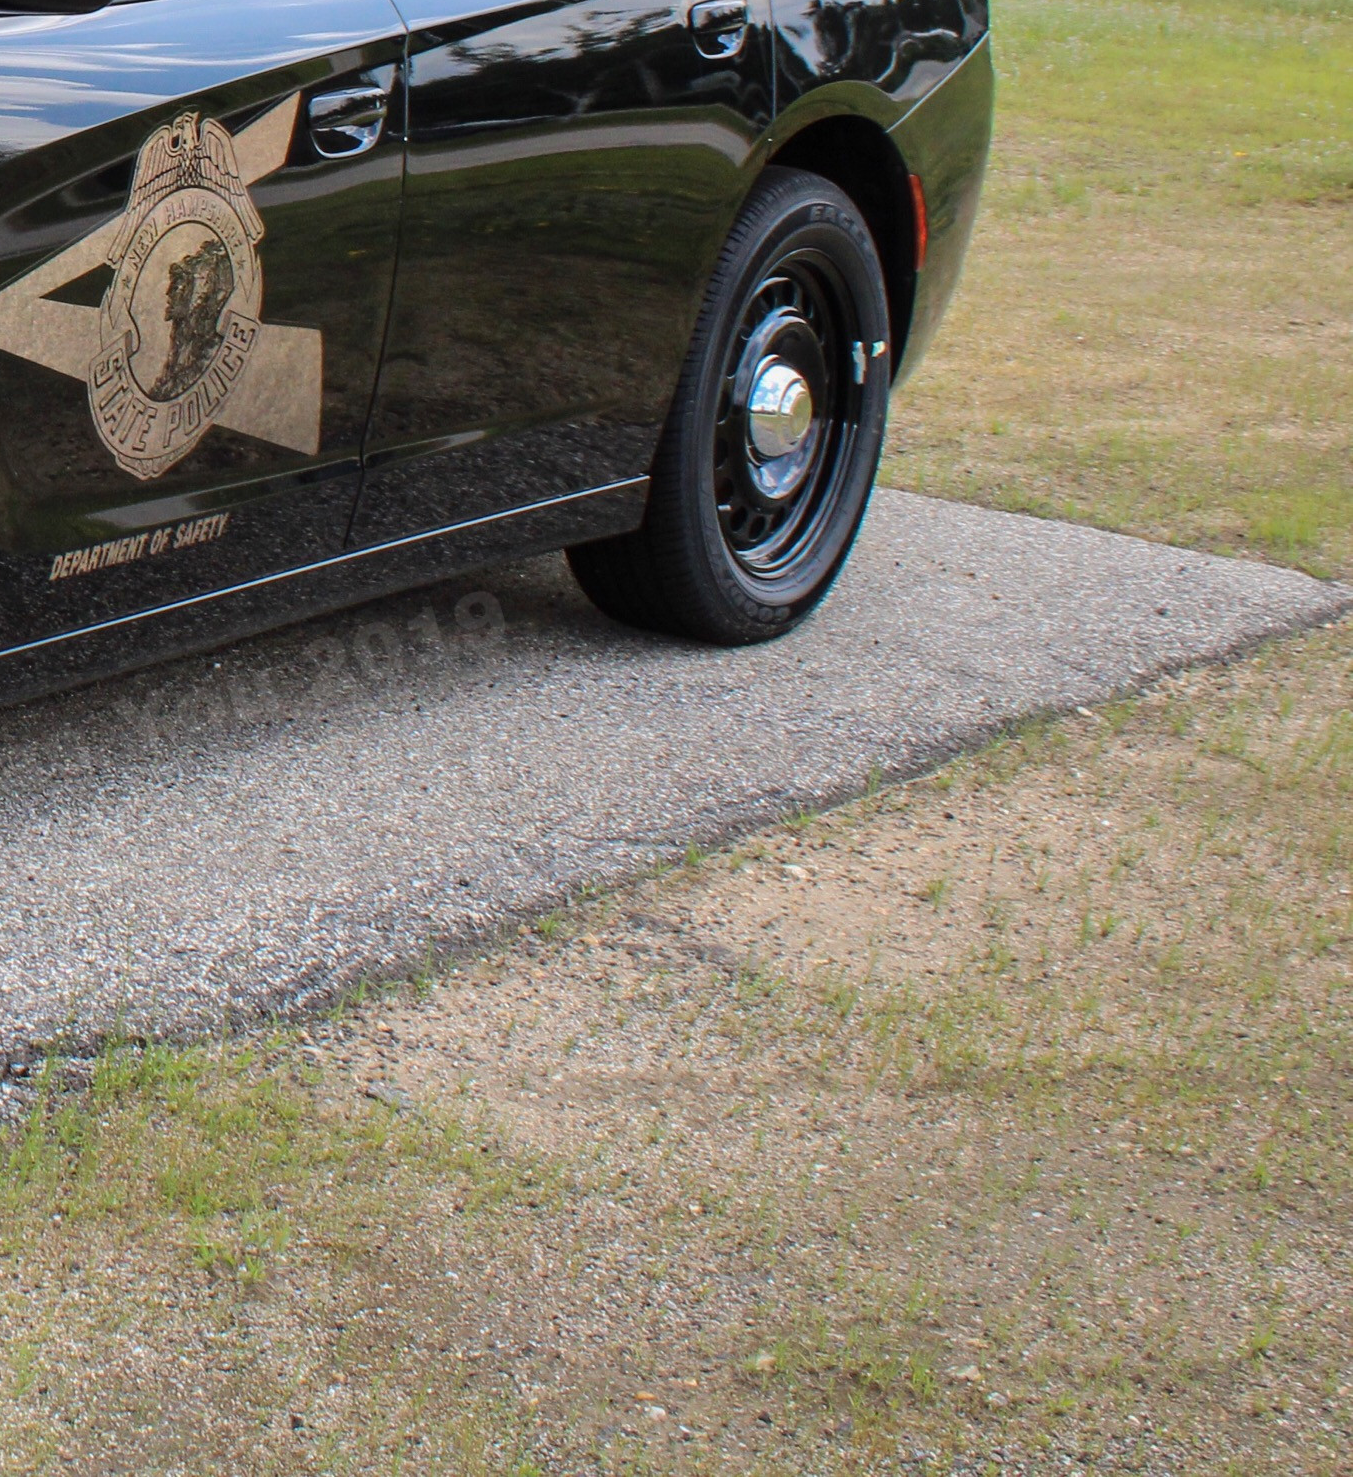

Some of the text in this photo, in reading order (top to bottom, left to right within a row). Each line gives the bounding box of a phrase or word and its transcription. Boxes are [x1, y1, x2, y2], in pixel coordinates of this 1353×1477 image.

[126, 197, 245, 271] NEW HAMPSHIRE
[94, 321, 256, 453] STATE POLICE
[49, 511, 231, 582] DEPARTMENT OF SAFETY
